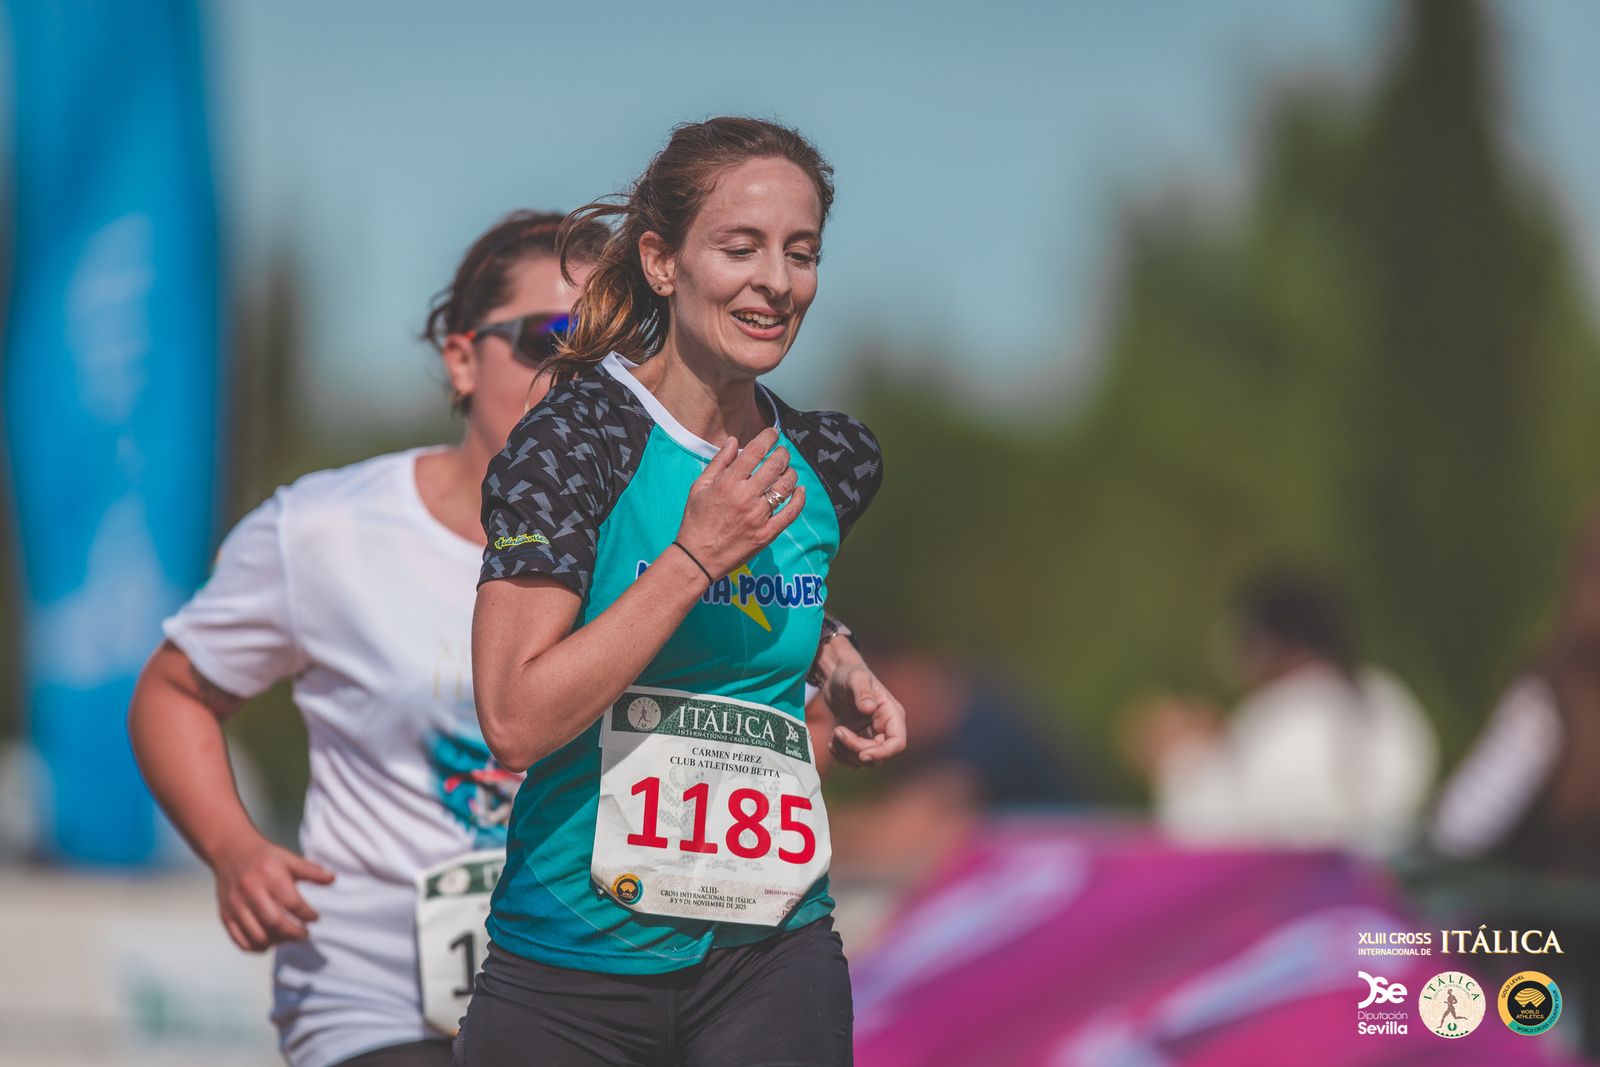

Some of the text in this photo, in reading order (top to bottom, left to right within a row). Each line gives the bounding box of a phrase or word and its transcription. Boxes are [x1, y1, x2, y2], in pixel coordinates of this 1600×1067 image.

[738, 574, 824, 607] POWER
[678, 704, 775, 742] ITÁLICA
[678, 729, 727, 741] INTERNATIONAL
[729, 736, 749, 745] CROSS
[691, 746, 763, 765] CARMEN PÉREZ
[669, 756, 781, 779] CLUB ATLETISMO BETTA
[627, 776, 816, 865] 1185
[660, 889, 679, 899] CROSS
[679, 891, 725, 902] INTERNACIONAL
[726, 895, 734, 903] DE
[683, 898, 693, 906] DE
[693, 899, 725, 909] NOVIEMBRE
[726, 902, 734, 910] DE
[735, 902, 747, 911] 2025
